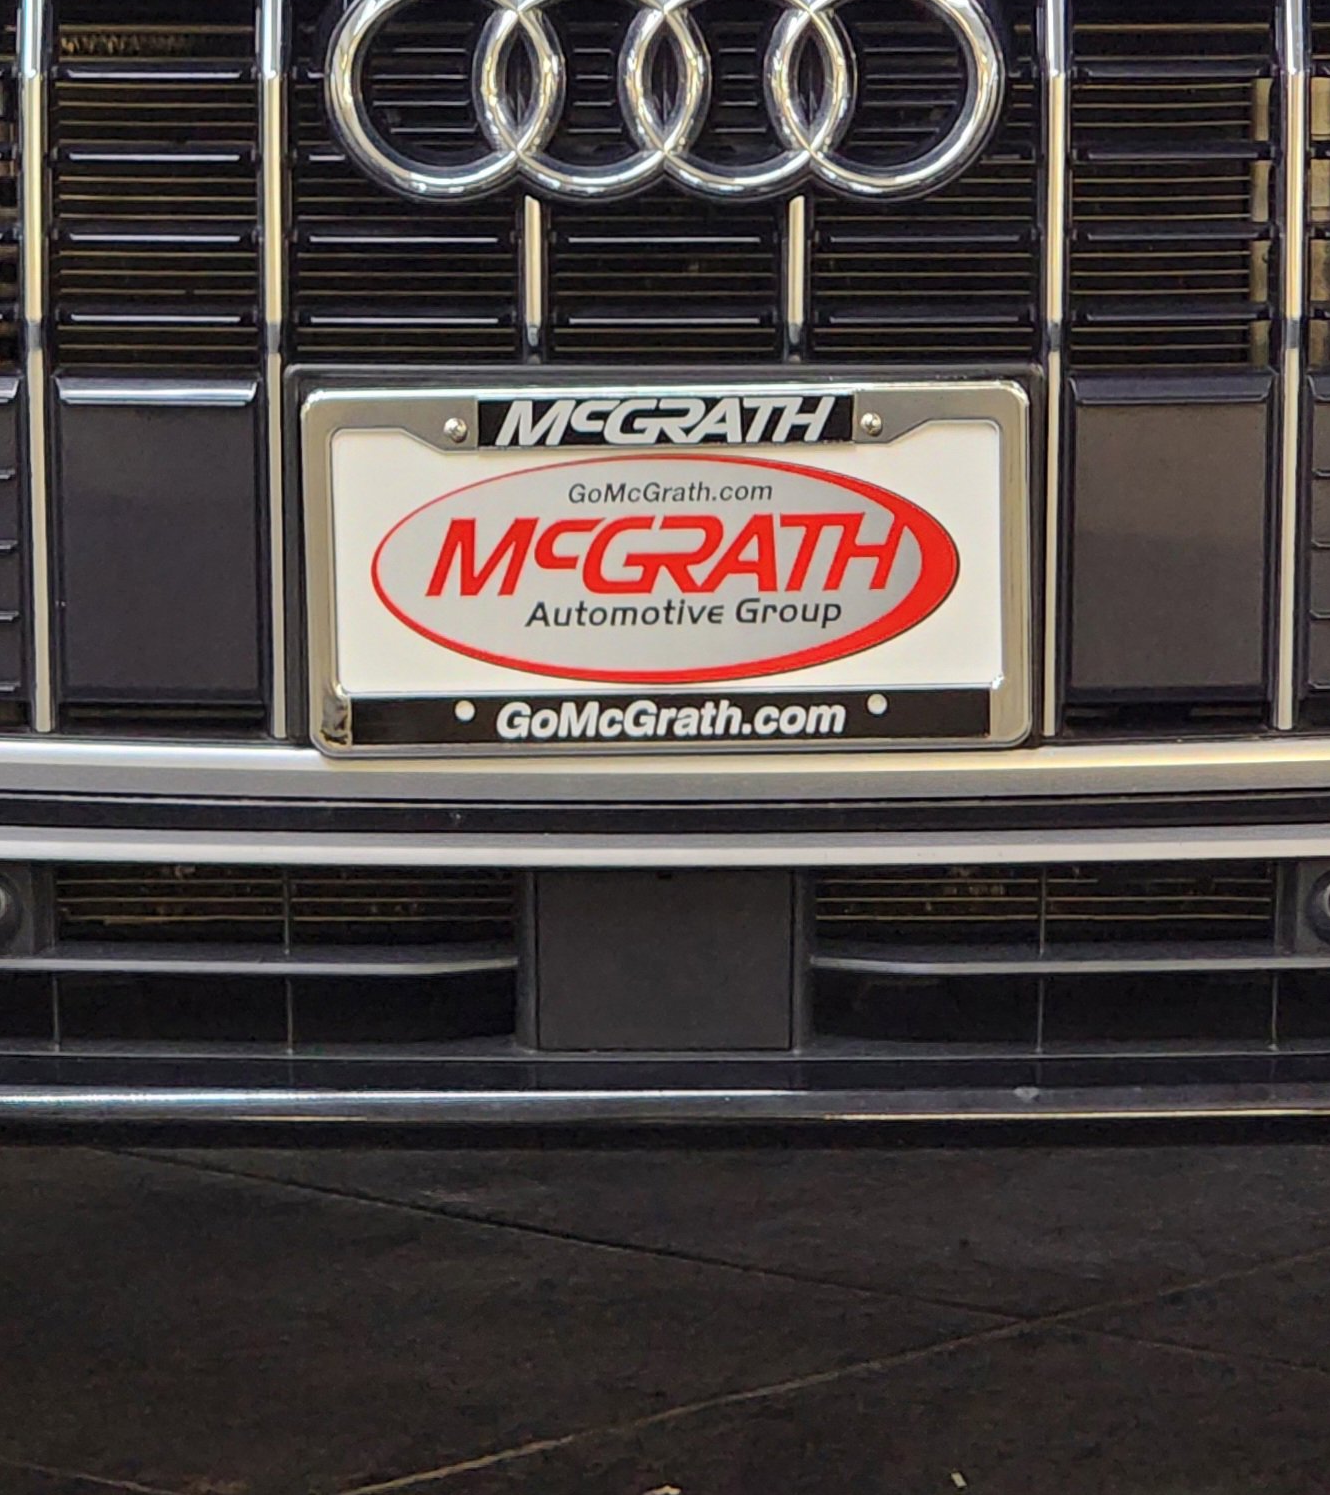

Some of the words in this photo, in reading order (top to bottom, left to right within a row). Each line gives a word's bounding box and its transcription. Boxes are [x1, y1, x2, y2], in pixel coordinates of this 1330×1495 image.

[567, 480, 773, 504] GoMcGrath.com
[524, 597, 724, 629] Automotive
[734, 596, 843, 629] Group
[495, 700, 846, 739] GoMcGrath.com
